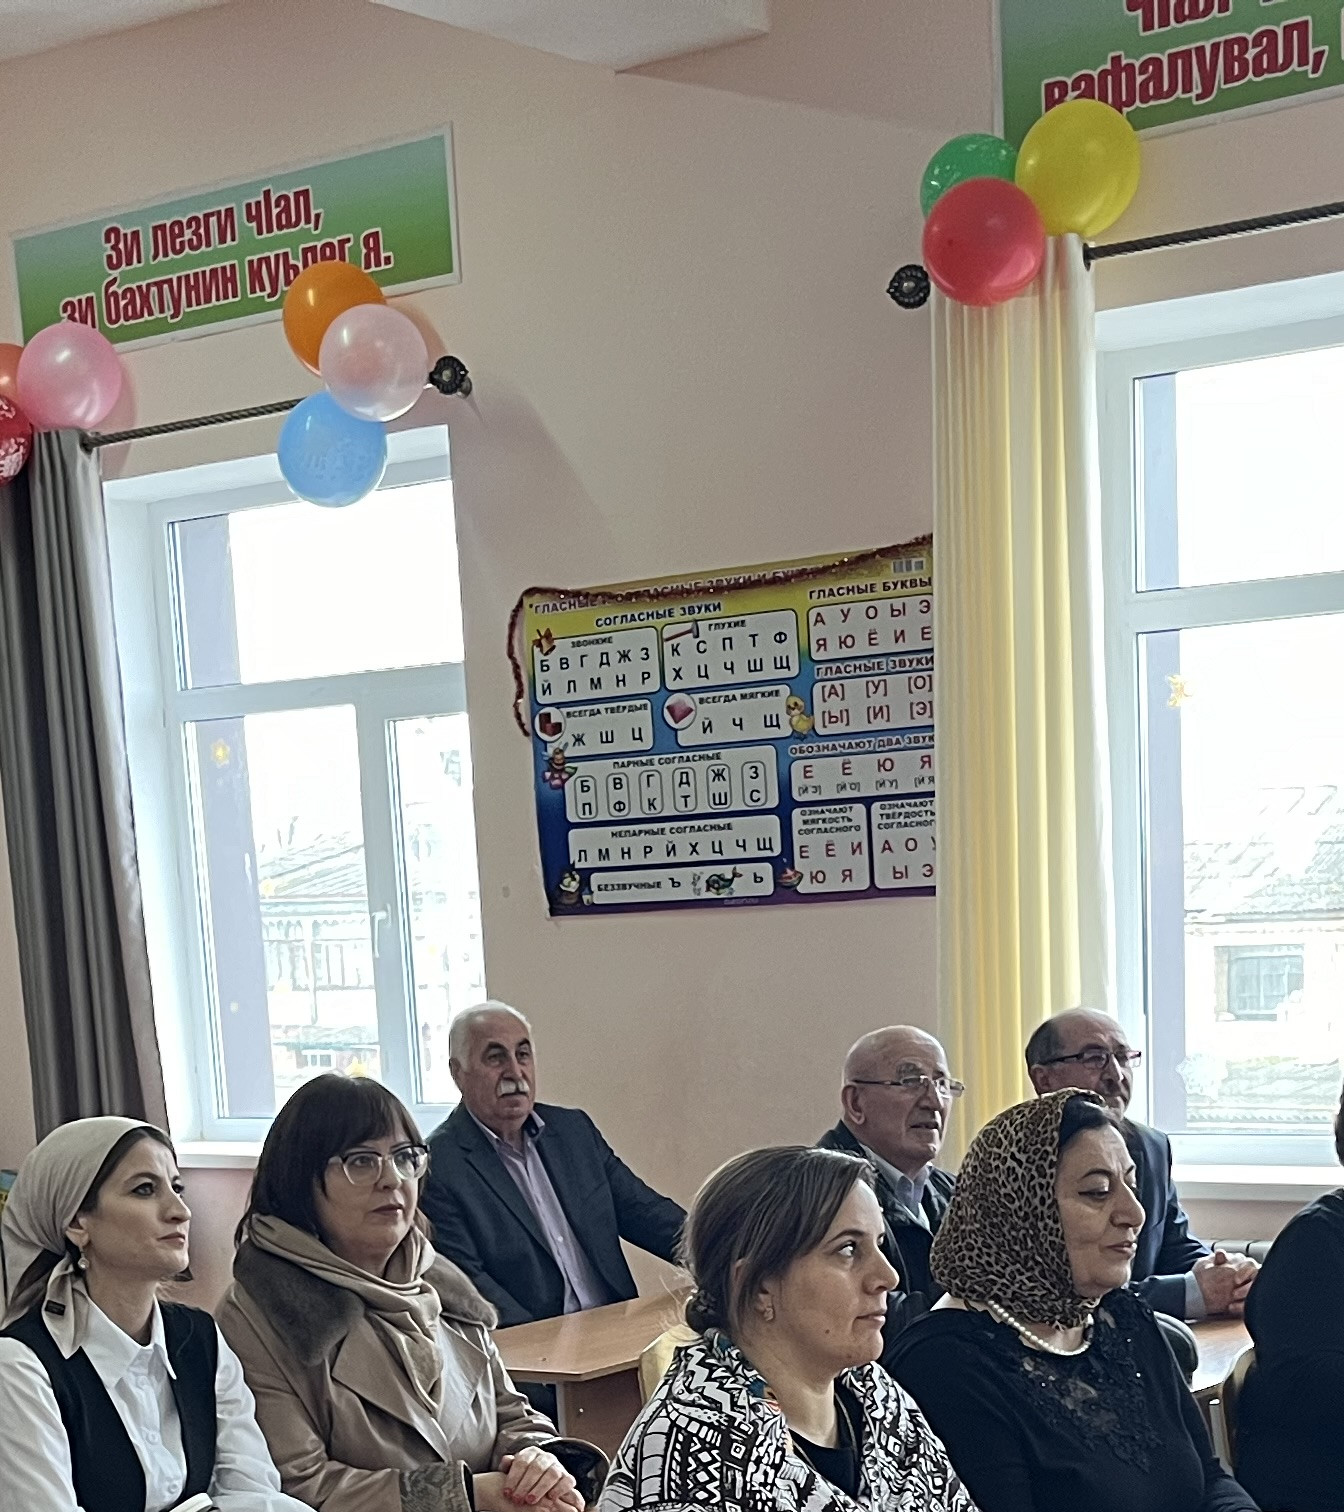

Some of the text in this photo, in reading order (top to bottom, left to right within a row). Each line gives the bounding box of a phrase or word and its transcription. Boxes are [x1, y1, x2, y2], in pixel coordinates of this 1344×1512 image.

[104, 226, 142, 271] Зи
[151, 207, 236, 260] лезги
[104, 262, 239, 326] бахтунин
[362, 230, 392, 270] я.
[809, 577, 933, 600] ГЛАСНЫЕ БУКВЫ
[596, 602, 722, 628] СОГЛАСНЫЕ ЗВУКИ
[814, 599, 931, 627] А У О Ы Э
[708, 620, 747, 632] ГЛУХИЕ
[571, 636, 613, 648] ЗВОНКИЕ
[671, 631, 788, 657] К С П Т Ф
[815, 626, 932, 653] Я Ю Ё И Е
[540, 647, 650, 672] Б В Г Д Ж З
[672, 655, 791, 681] Х Ц Ч Ш Щ
[816, 655, 934, 677] ГЛАСНЫЕ ЗВУКИ
[542, 671, 651, 696] Й Л М Н Р
[821, 674, 933, 702] [А] [У] [О]
[698, 688, 780, 705] ВСЕГДА МЯГКИЕ
[566, 702, 648, 719] ВСЕГДА ТВЁРДЫЕ
[821, 700, 934, 728] [Ы] [И] [Э]
[702, 713, 781, 734] Й Ч Щ
[571, 727, 643, 746] Ж Ш Ц
[789, 739, 873, 755] ОБОЗНАЧАЮТ
[877, 737, 902, 749] ДВА
[612, 752, 722, 769] ПАРНЫЕ СОГЛАСНЫЕ
[611, 822, 733, 838] НЕПАРНЫЕ СОГЛАСНЫЕ
[597, 881, 662, 891] БЕЗЗВУЧНЫЕ
